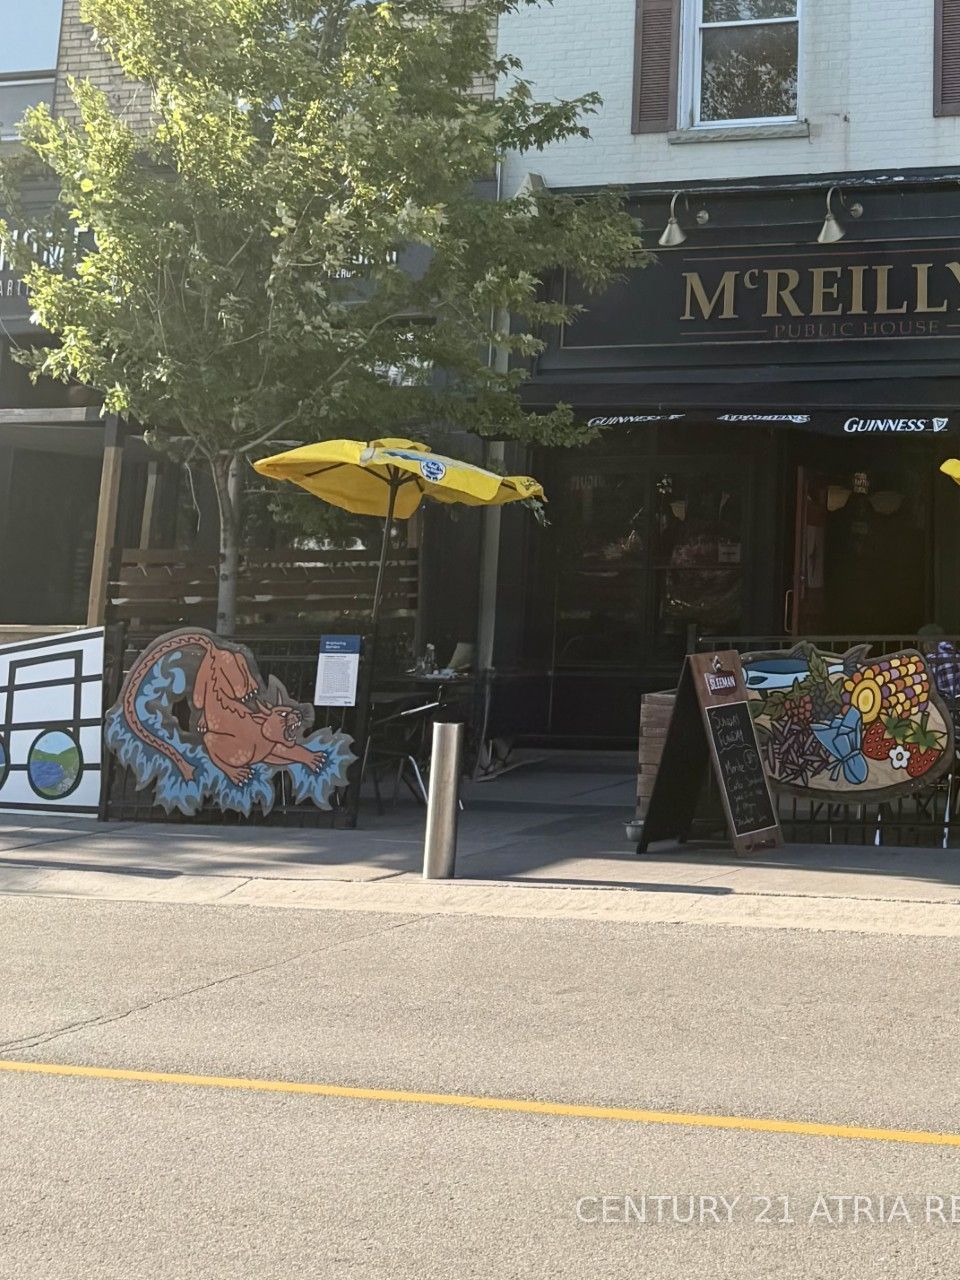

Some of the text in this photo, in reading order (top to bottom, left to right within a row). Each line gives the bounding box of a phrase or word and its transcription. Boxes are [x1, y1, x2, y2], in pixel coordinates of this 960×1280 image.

[774, 321, 939, 338] PUBLIC HOUSE
[844, 417, 925, 432] GUINNESS
[710, 676, 736, 690] SLEEMAN
